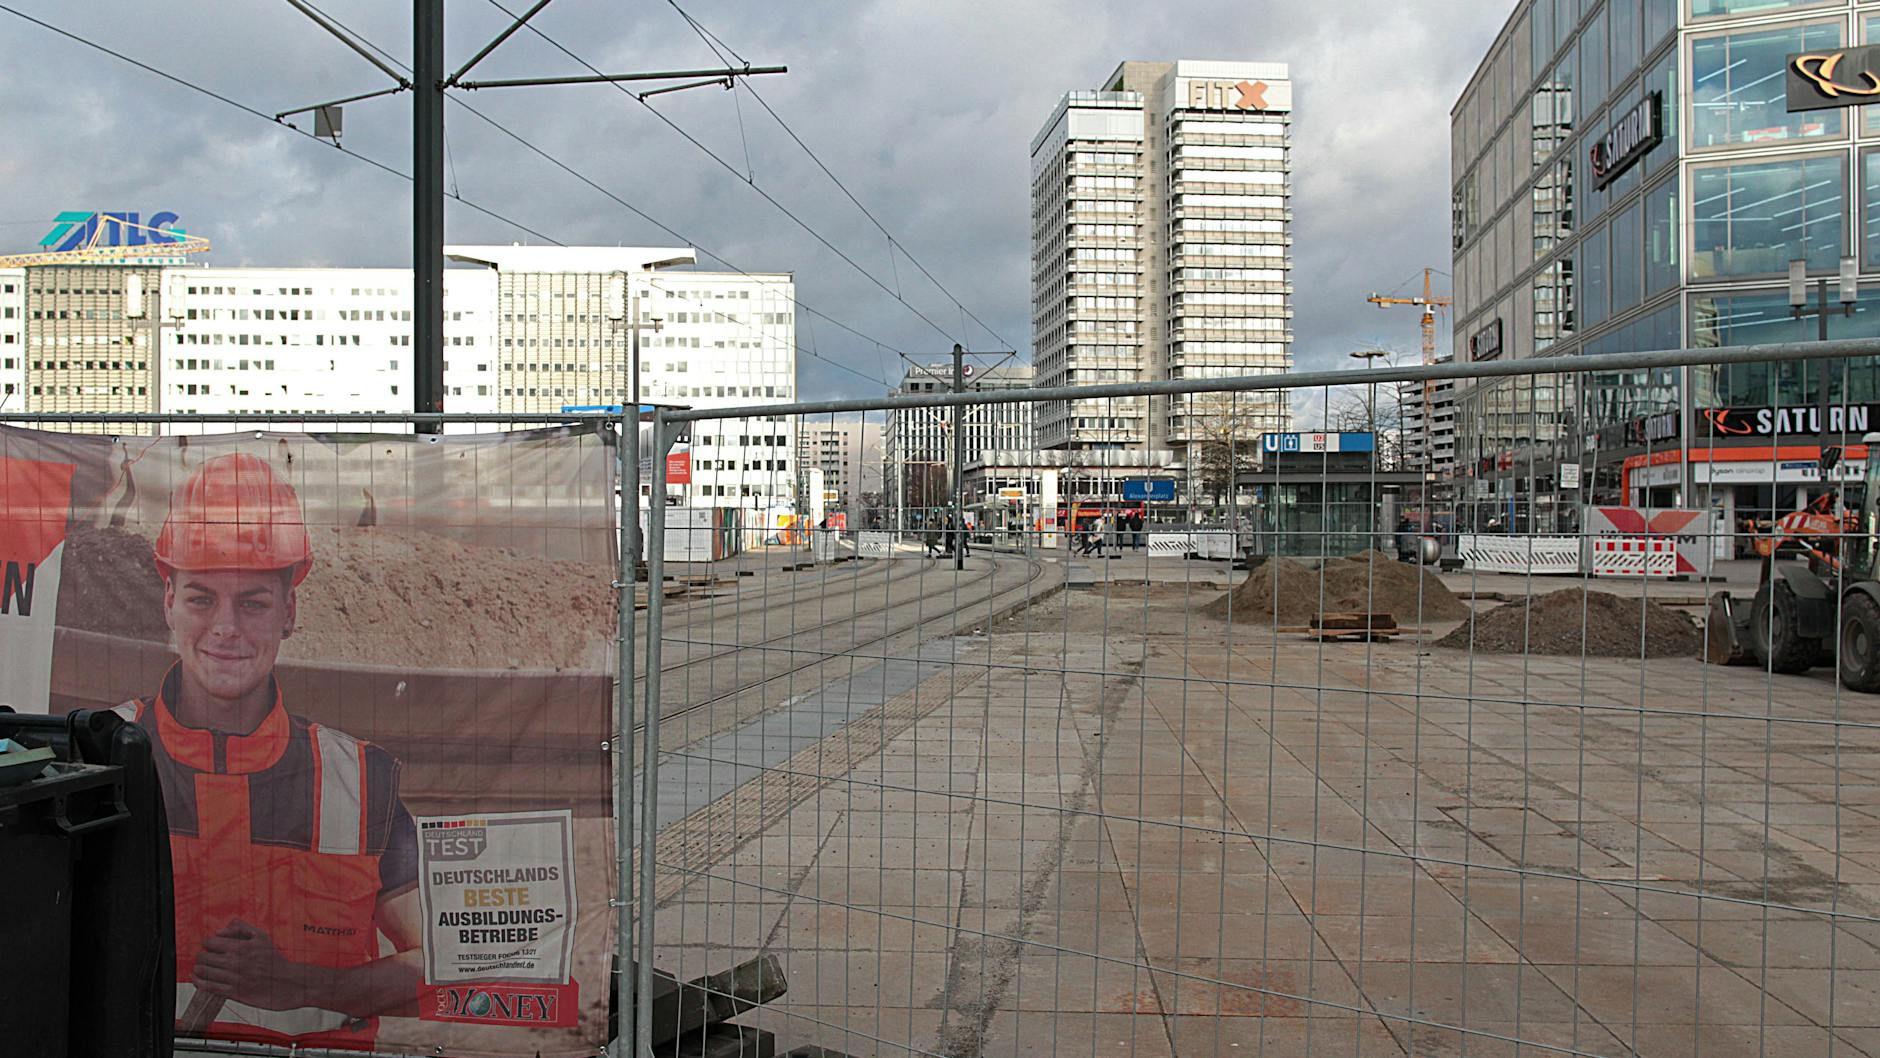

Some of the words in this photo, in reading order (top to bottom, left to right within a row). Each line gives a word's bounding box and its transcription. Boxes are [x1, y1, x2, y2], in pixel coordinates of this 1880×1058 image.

[1188, 80, 1269, 110] FITX
[1606, 99, 1650, 169] SATURN
[915, 366, 947, 375] Premier
[1756, 406, 1868, 433] SATURN
[1265, 434, 1279, 451] U
[1144, 481, 1154, 493] U
[1129, 492, 1169, 500] Alexanerplatz
[425, 830, 484, 838] DEUTSCHLAND
[426, 838, 484, 856] TEST
[432, 866, 559, 885] DEUTSCHLANDS
[463, 887, 530, 907] BESTE
[438, 909, 563, 926] AUSBILDUNGS-
[459, 927, 538, 944] BETRIEBE
[458, 953, 497, 961] TESTSIEGER
